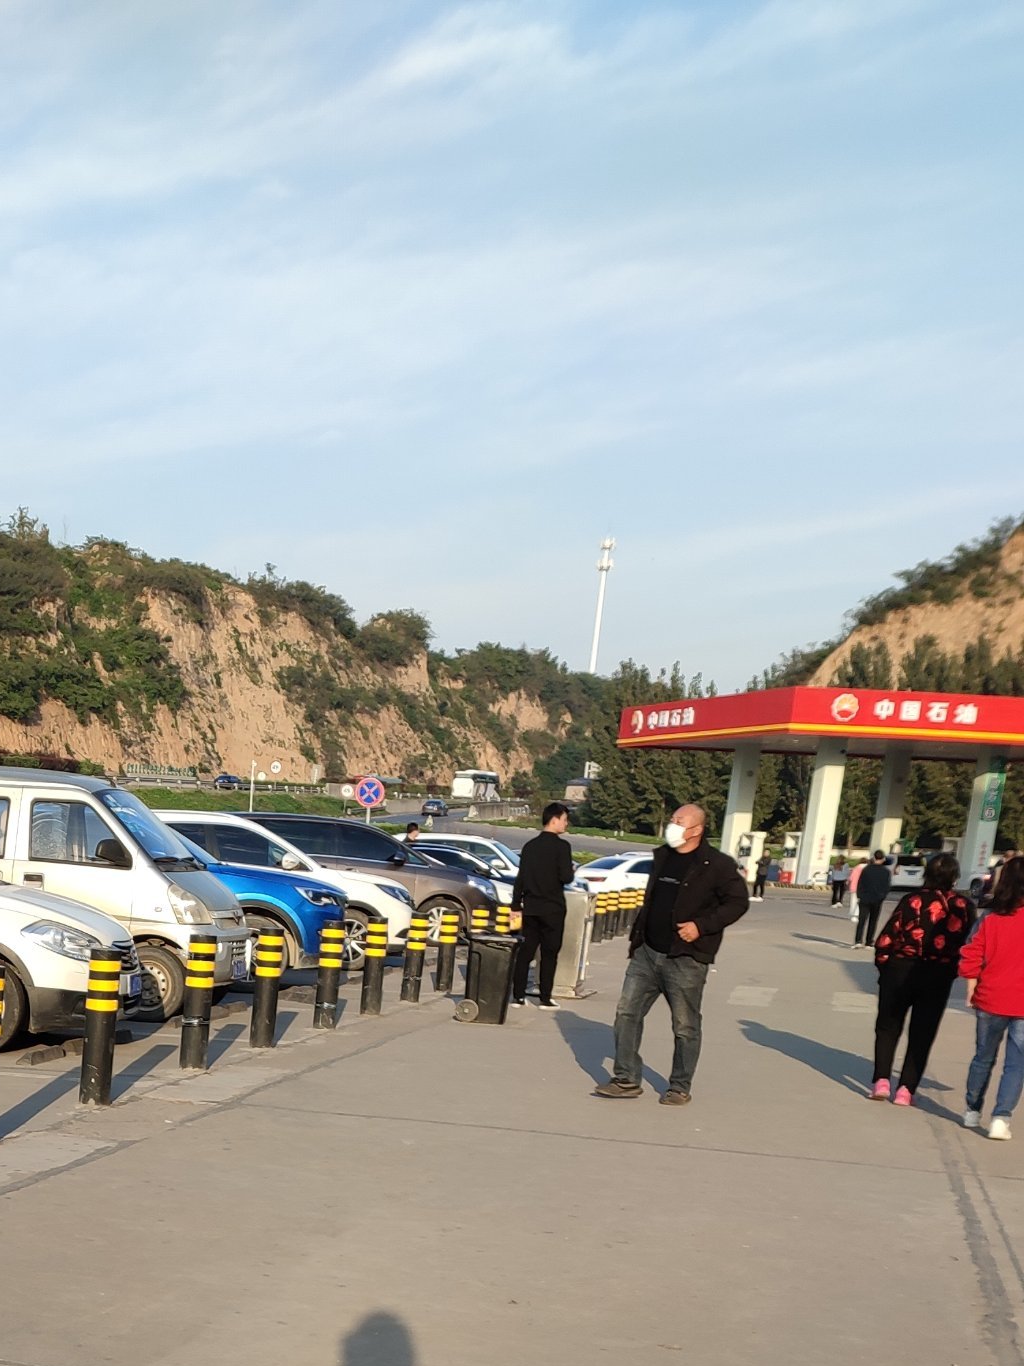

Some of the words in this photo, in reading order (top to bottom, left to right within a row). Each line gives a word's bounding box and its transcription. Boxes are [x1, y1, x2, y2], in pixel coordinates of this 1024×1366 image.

[647, 707, 695, 730] 中国石油
[873, 699, 979, 725] 中国石油
